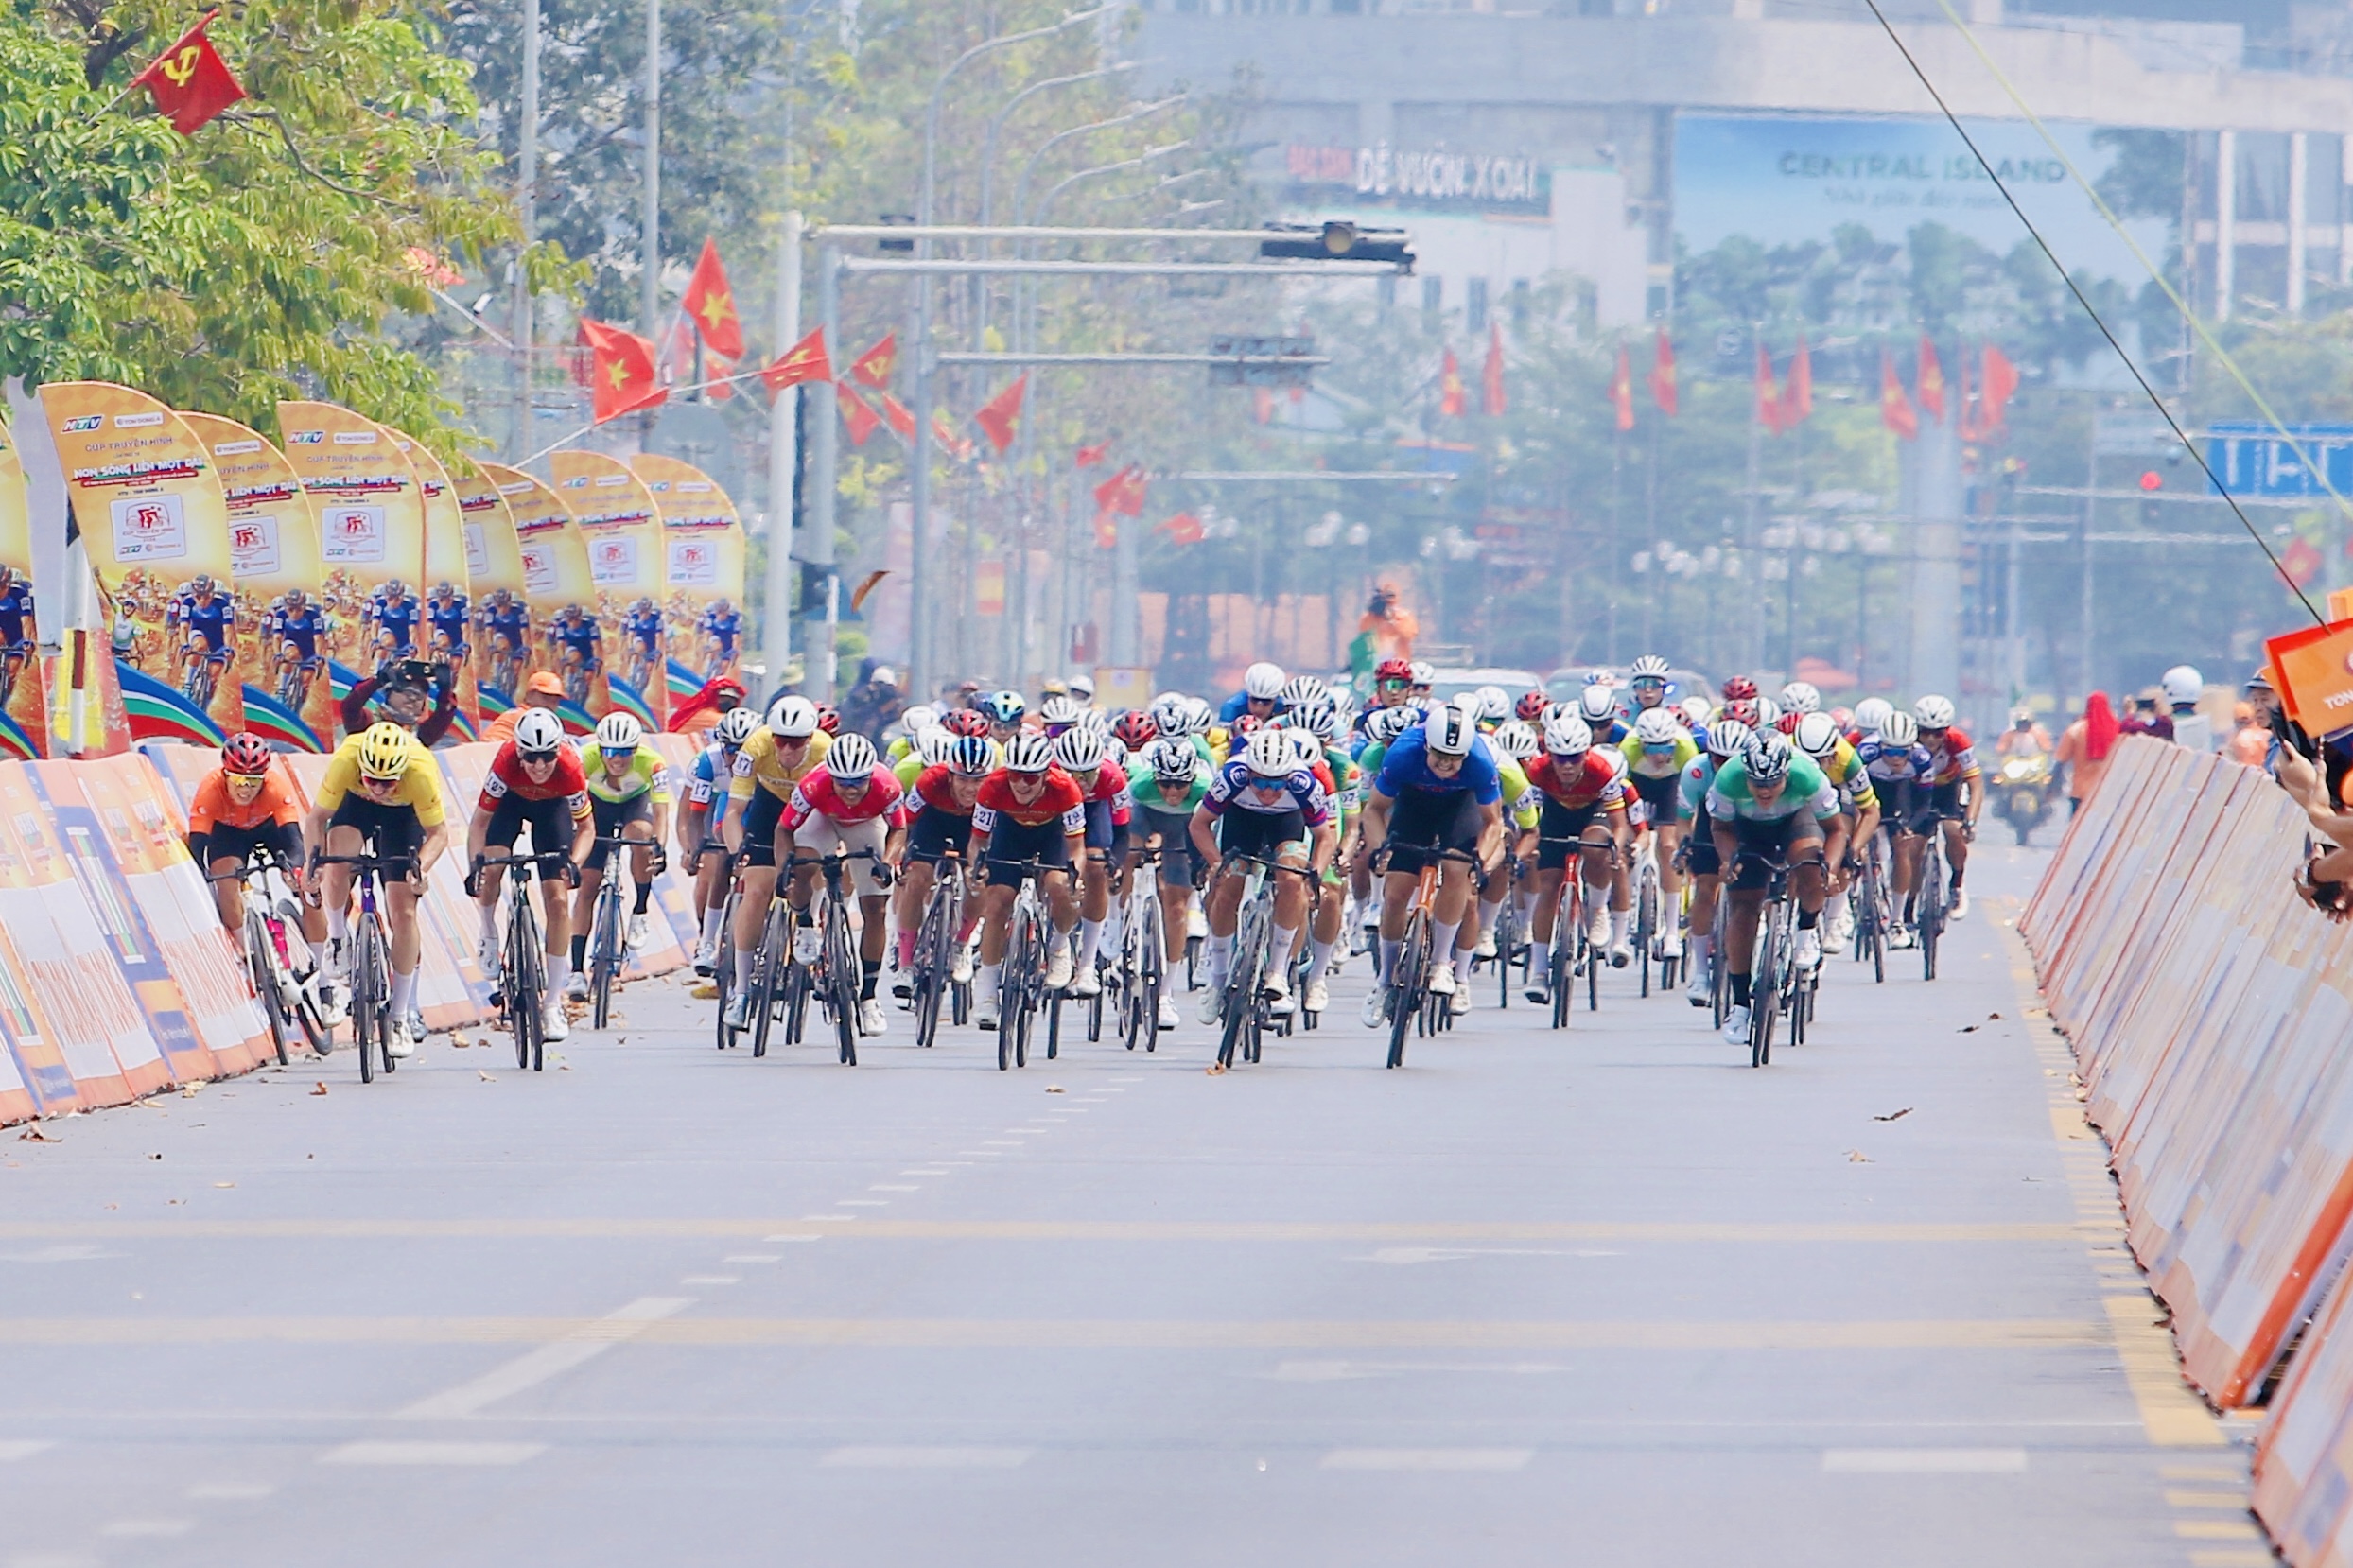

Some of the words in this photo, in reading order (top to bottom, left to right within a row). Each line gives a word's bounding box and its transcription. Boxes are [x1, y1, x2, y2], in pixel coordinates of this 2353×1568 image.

[1779, 150, 1932, 180] CENTRAL
[1943, 155, 2069, 183] ISLAND
[62, 416, 102, 432] HTV
[288, 431, 324, 444] HTV
[695, 782, 709, 796] 17
